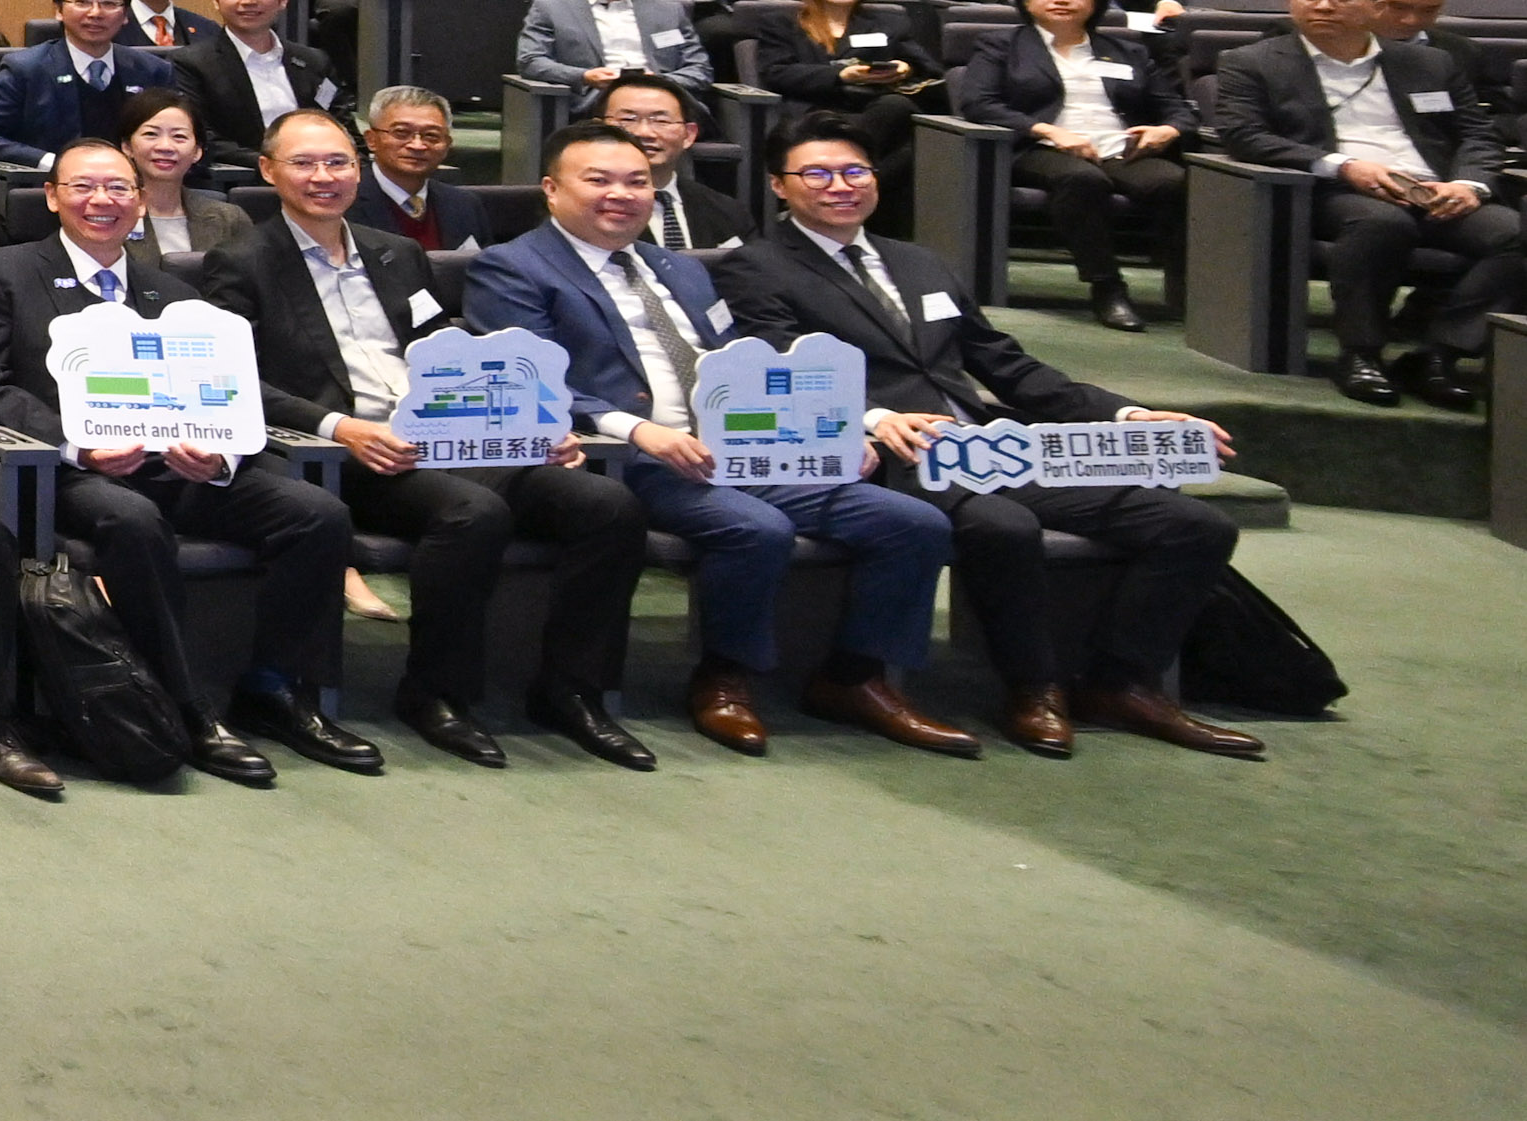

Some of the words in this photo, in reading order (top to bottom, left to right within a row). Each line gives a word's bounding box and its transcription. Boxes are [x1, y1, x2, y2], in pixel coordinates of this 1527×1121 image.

[84, 419, 147, 437] Connect
[152, 423, 179, 438] and
[184, 423, 233, 440] Thrive
[928, 433, 1033, 481] PCS
[1040, 430, 1208, 459] 港口社區系統
[1043, 460, 1073, 478] Port
[1075, 459, 1153, 480] Community
[1158, 458, 1211, 476] System
